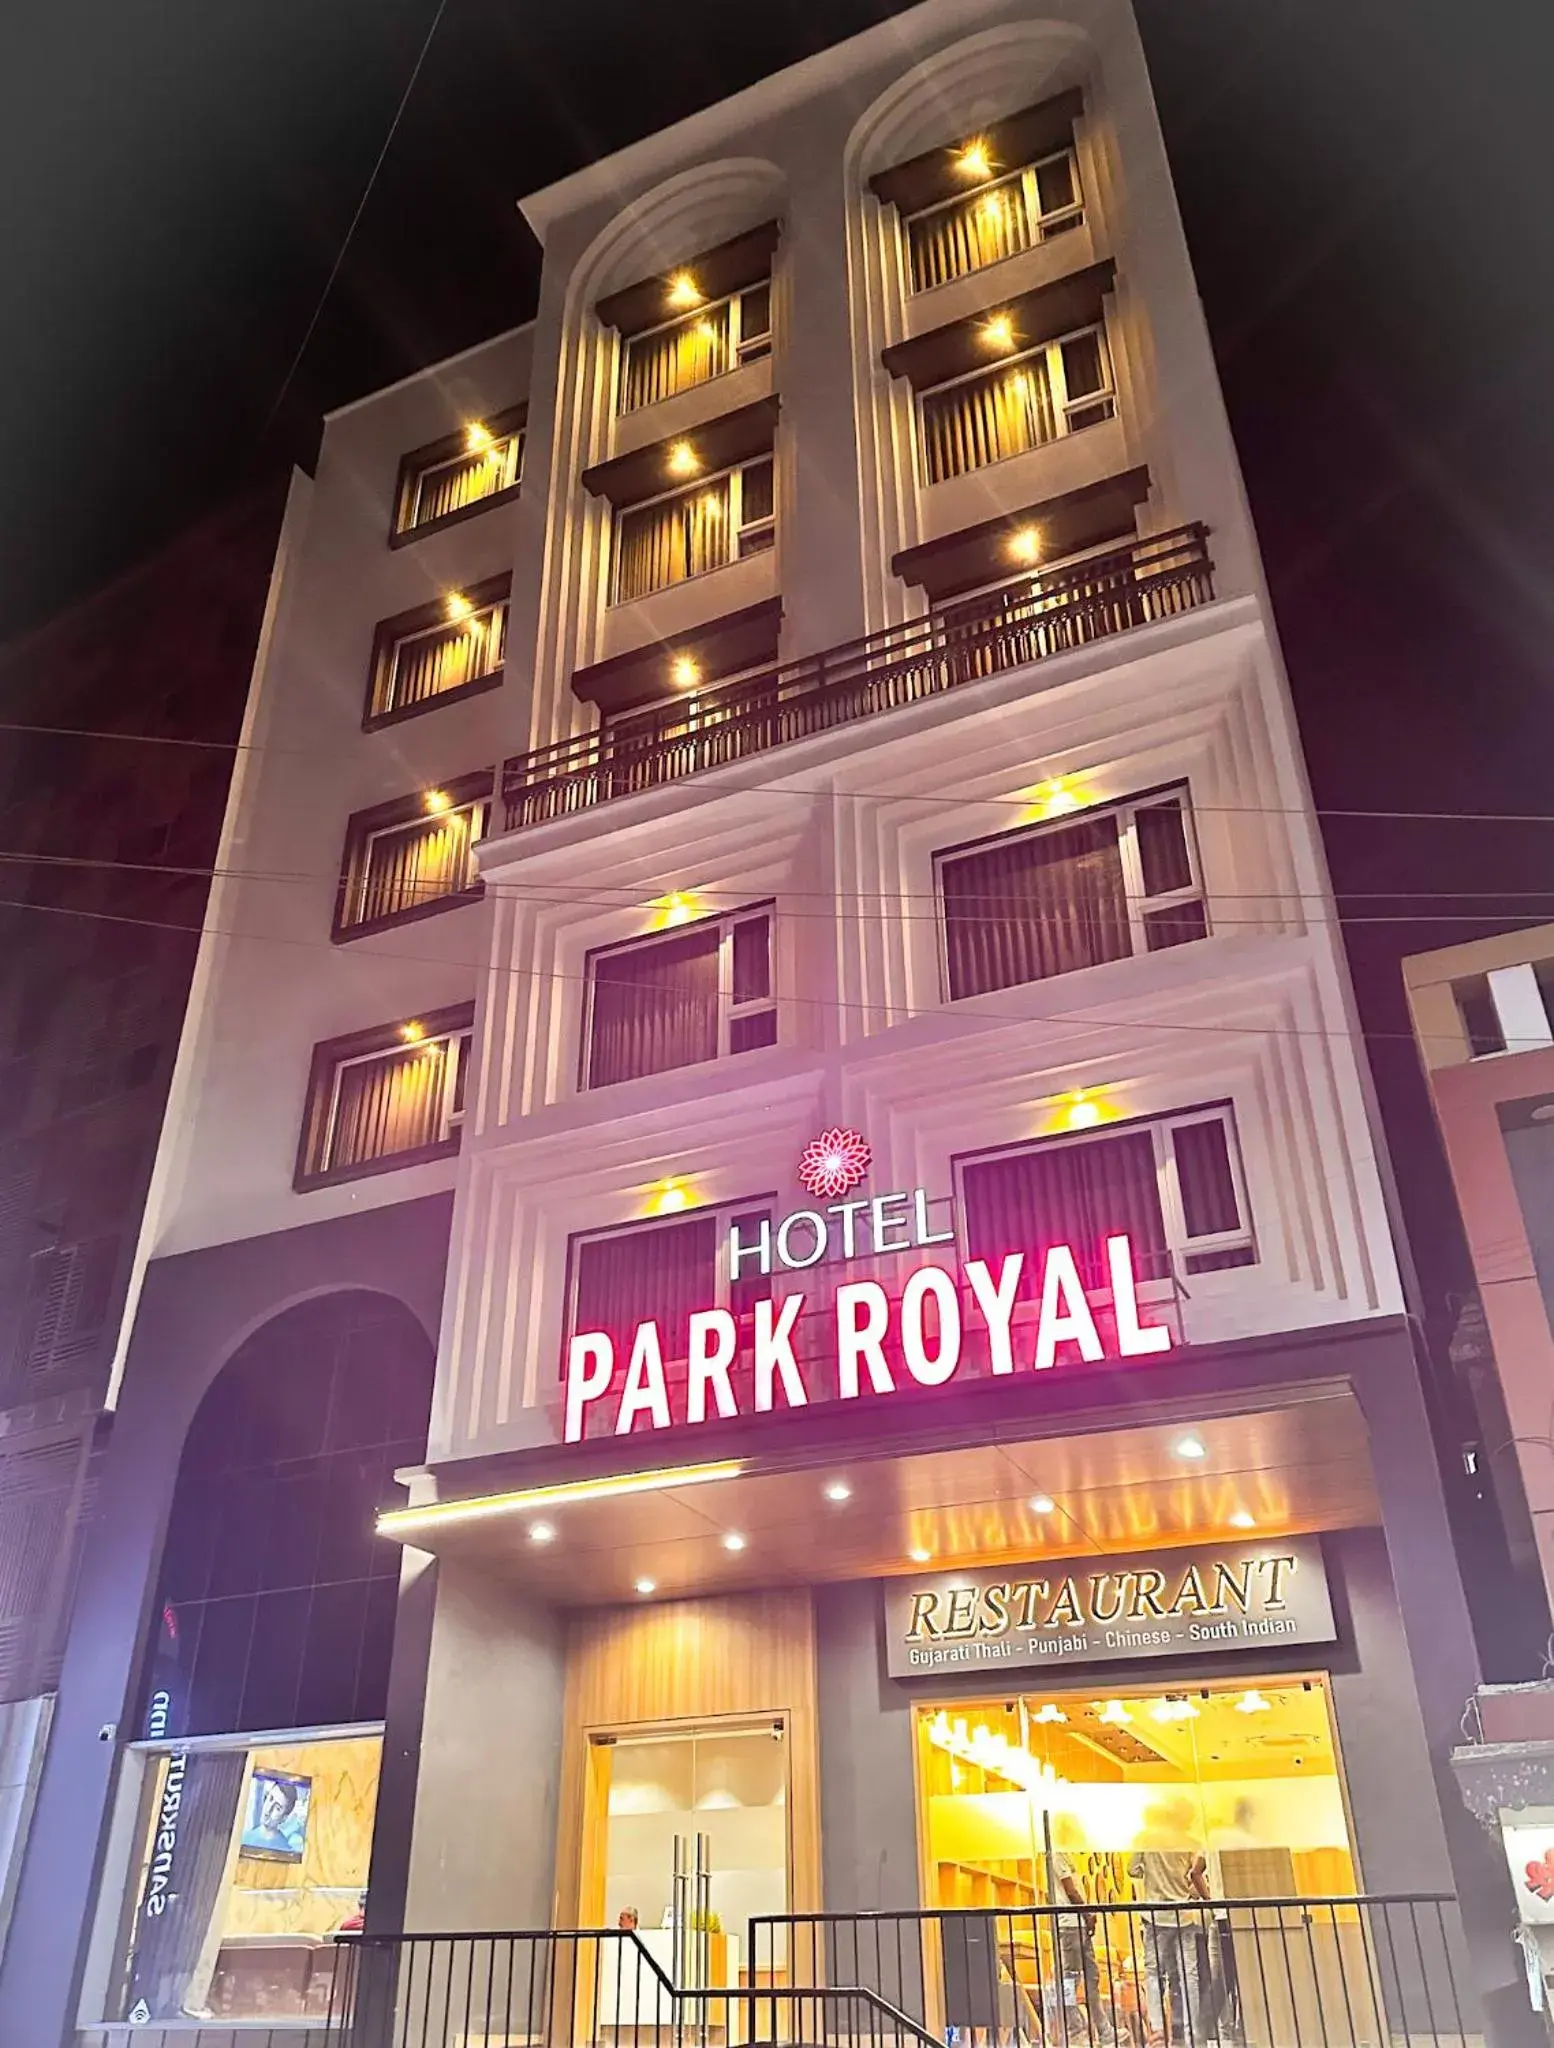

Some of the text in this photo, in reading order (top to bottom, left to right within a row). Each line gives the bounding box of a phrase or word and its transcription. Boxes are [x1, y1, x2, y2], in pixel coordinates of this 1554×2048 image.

[728, 1188, 955, 1281] HOTEL
[563, 1233, 1172, 1444] PARK ROYAL
[905, 1554, 1297, 1643] RESTAURANT
[909, 1644, 970, 1668] Gujarati
[972, 1640, 1012, 1660] Thali
[1028, 1633, 1088, 1656] Punjabi
[1105, 1629, 1171, 1648] Chinese
[1189, 1617, 1238, 1641] South
[1242, 1617, 1297, 1636] Indian
